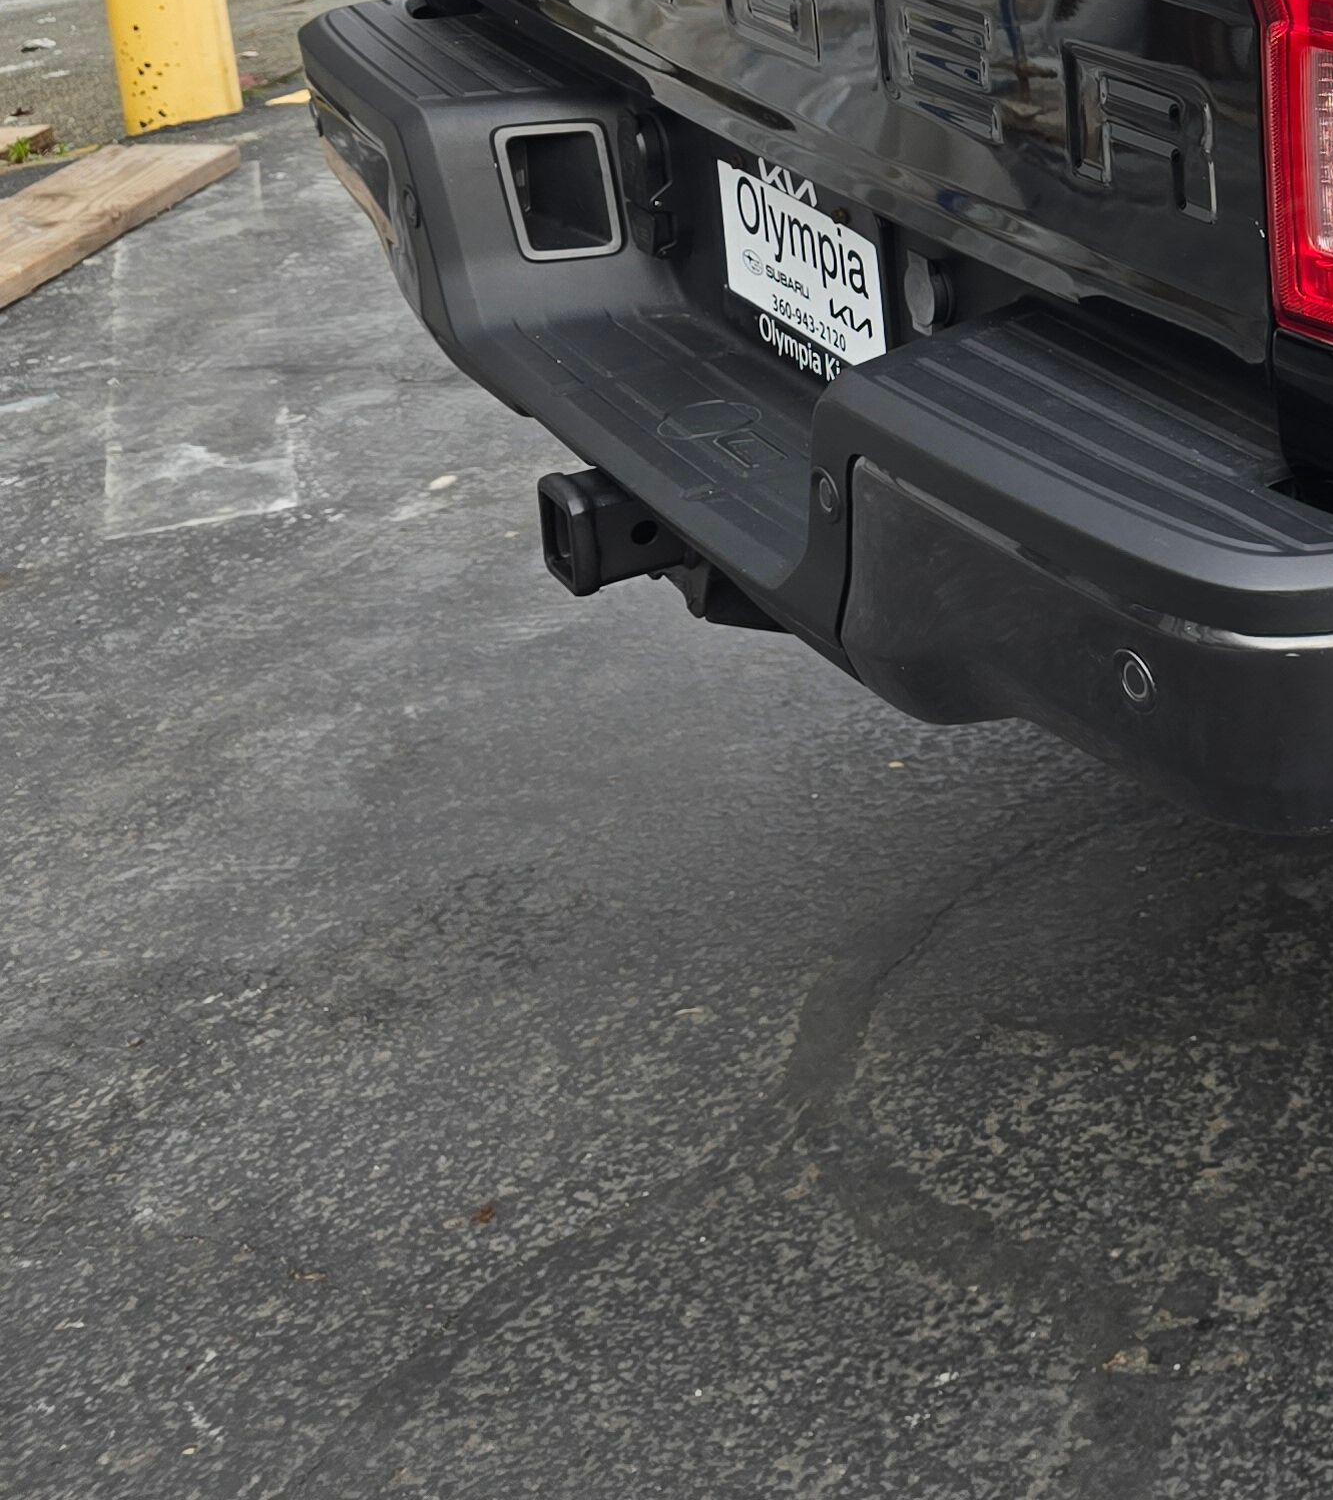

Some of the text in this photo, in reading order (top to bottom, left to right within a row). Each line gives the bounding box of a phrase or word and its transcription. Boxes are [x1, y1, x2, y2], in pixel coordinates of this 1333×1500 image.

[737, 176, 869, 300] Olympia
[765, 264, 810, 300] SUBARU
[758, 312, 841, 382] Olympia Ki
[771, 294, 846, 352] 360-943-2120
